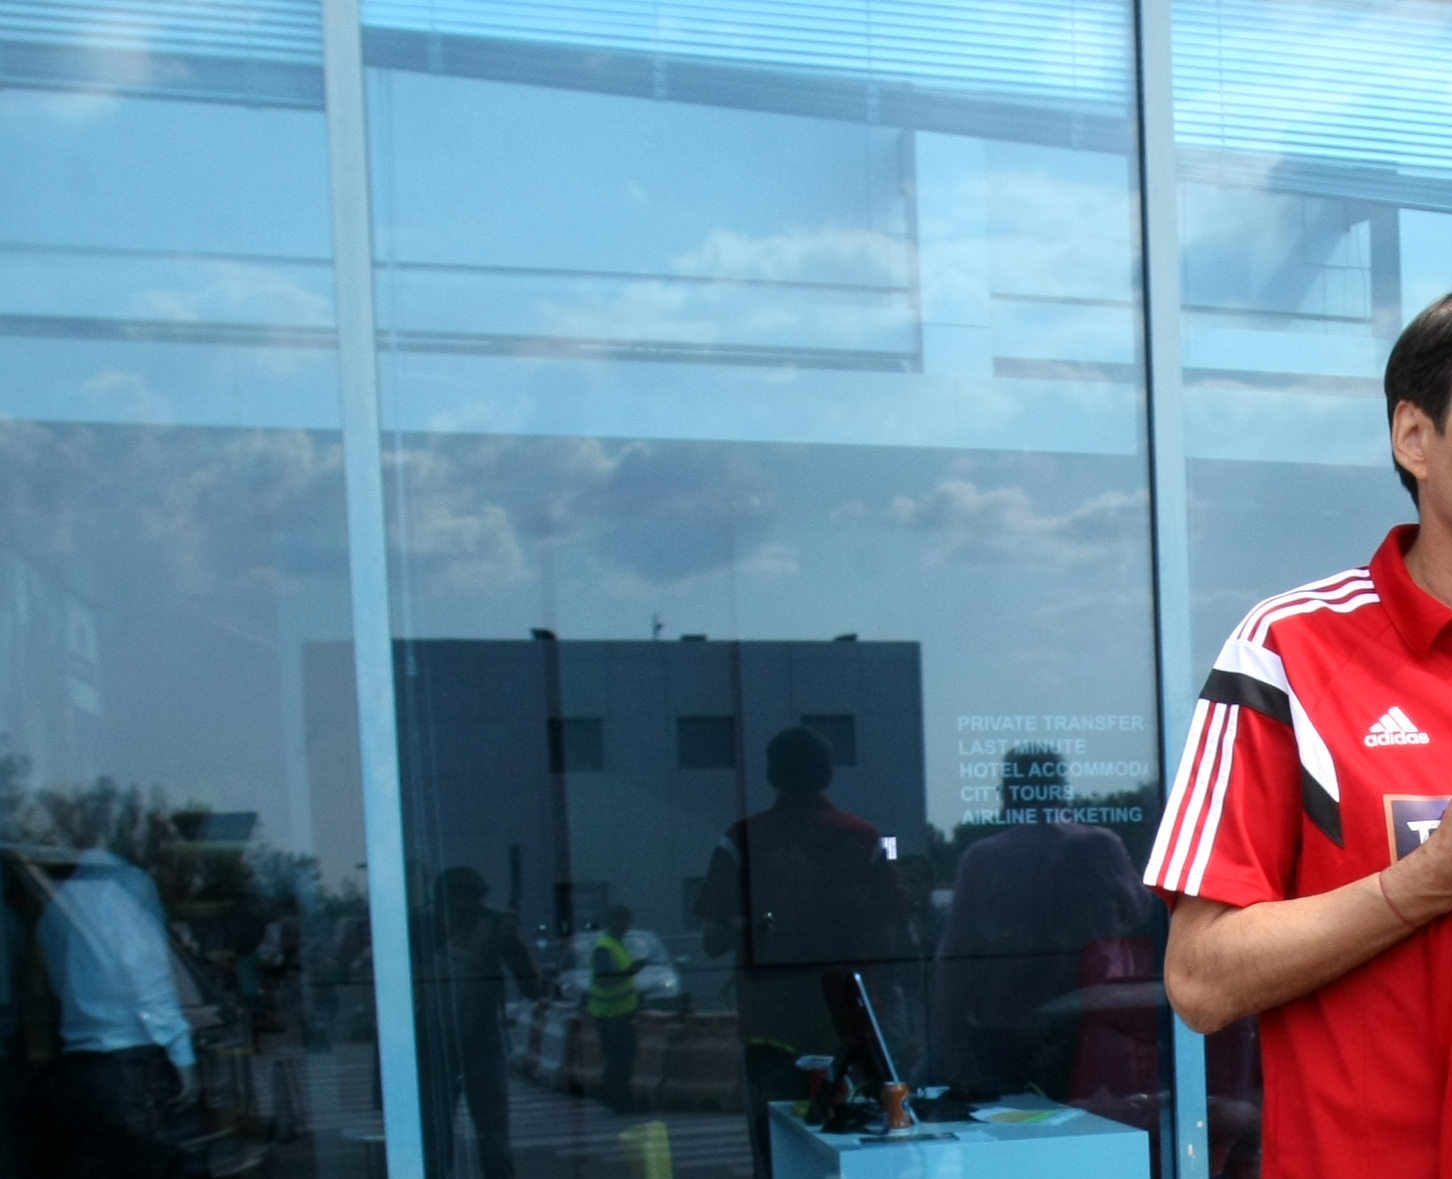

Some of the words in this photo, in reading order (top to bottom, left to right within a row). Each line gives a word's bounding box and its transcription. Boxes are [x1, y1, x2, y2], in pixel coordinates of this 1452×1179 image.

[957, 715, 1037, 731] PRIVATE
[1044, 715, 1144, 731] TRANSFER
[958, 739, 1008, 755] LAST
[1014, 738, 1085, 755] MINUTE
[1364, 730, 1430, 748] adidas
[960, 762, 1023, 778] HOTEL
[960, 785, 1003, 802] CITY
[1009, 785, 1074, 801] TOURS
[961, 808, 1037, 824] AIRLINE
[1043, 806, 1142, 823] TICKETING
